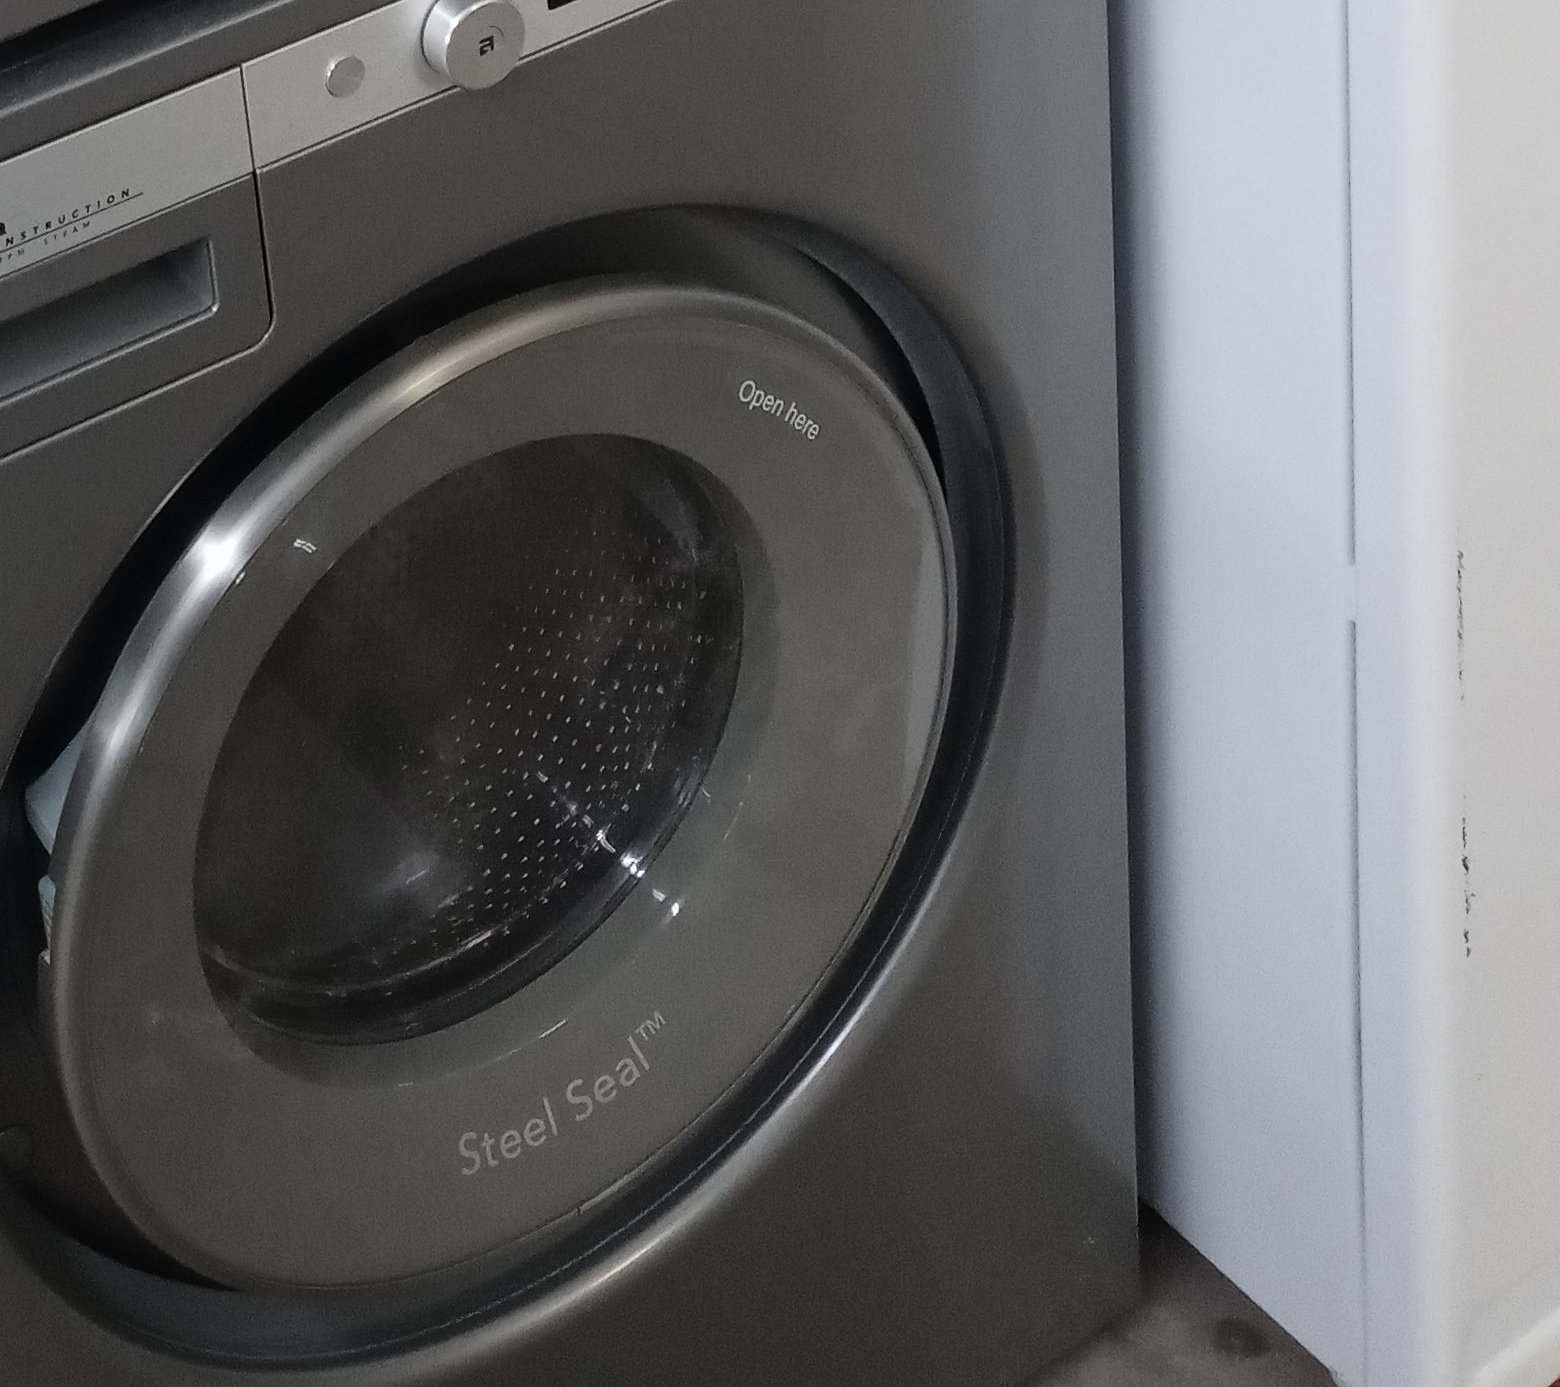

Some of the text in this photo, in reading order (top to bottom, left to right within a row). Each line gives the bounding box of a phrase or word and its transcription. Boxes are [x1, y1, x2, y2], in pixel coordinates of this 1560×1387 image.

[739, 380, 820, 440] Open here
[458, 1096, 559, 1176] Steel
